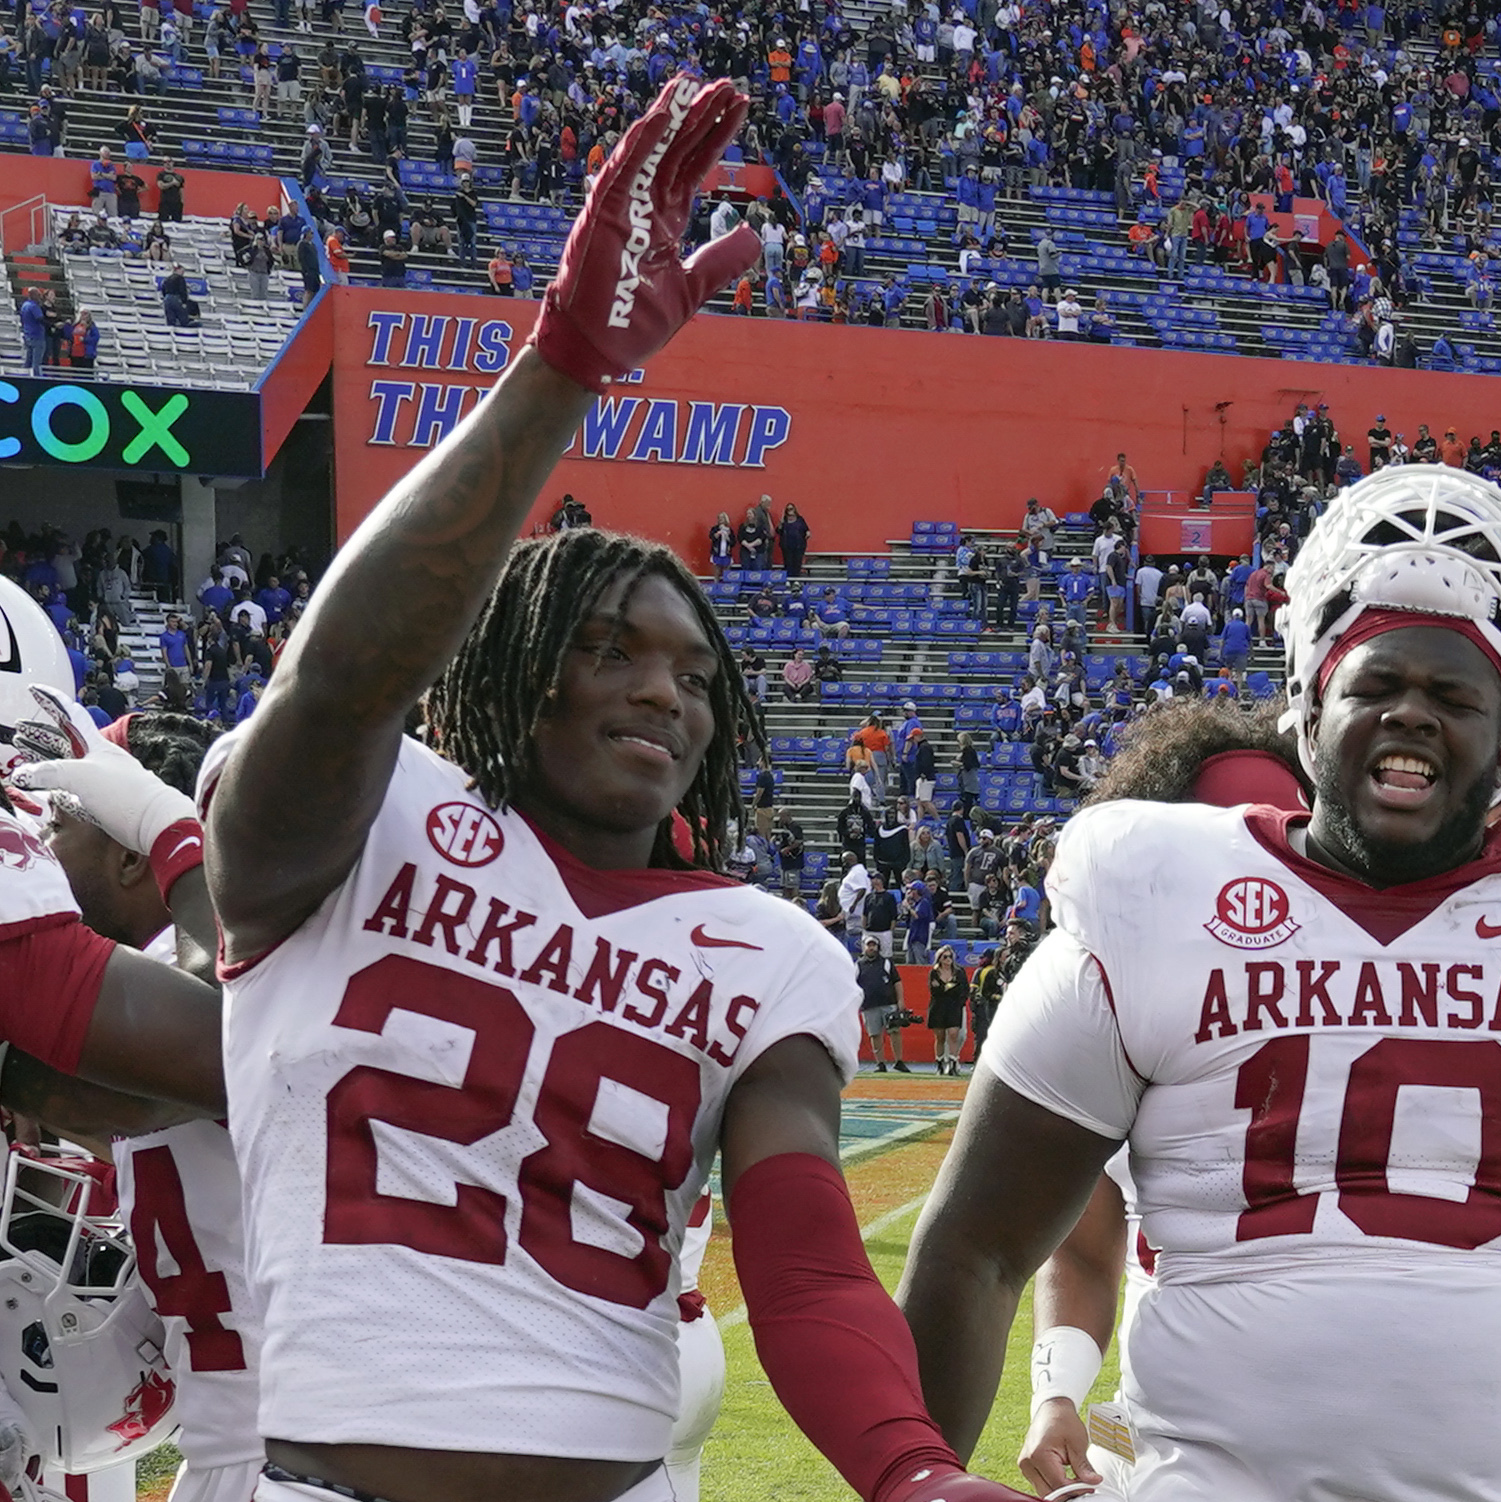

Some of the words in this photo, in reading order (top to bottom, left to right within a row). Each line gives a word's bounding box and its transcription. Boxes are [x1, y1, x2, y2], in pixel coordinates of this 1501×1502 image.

[366, 311, 514, 373] THIS
[366, 380, 496, 447] TH
[563, 394, 792, 467] WAMP
[1191, 531, 1201, 544] 2
[432, 805, 499, 862] SEC
[1225, 881, 1280, 930] SEC
[363, 862, 762, 1068] ARKANSAS
[1220, 927, 1285, 947] GRADUATE
[321, 953, 702, 1310] 28
